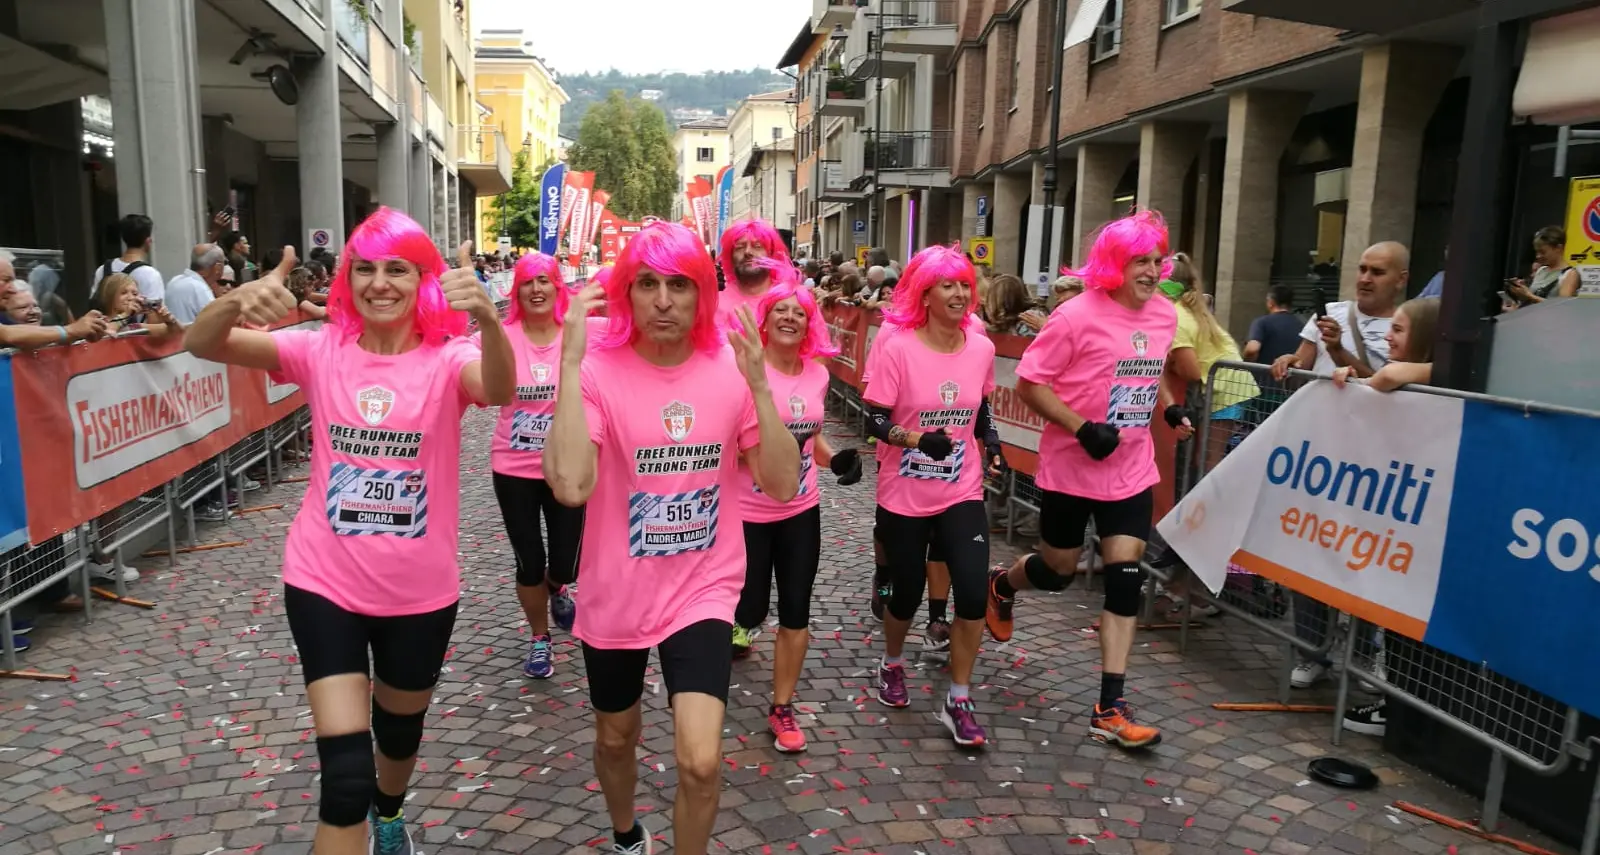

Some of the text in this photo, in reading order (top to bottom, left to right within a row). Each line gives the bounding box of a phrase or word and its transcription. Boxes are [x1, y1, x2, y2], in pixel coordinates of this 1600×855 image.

[1131, 393, 1147, 405] 203
[75, 372, 224, 463] FISHERMAN'S FRIEND
[531, 420, 548, 432] 247
[330, 424, 422, 444] FREE RUNNERS
[332, 439, 419, 458] STRONG TEAM
[636, 443, 722, 460] FREE RUNNERS
[638, 458, 720, 474] STRONG TEAM
[363, 480, 395, 501] 250
[1266, 440, 1435, 526] olomiti
[341, 499, 413, 513] FISHERMAN'S FRIEND
[667, 503, 692, 522] 515
[357, 512, 395, 525] CHIARA
[646, 527, 708, 545] ANDREA MARIA
[1279, 506, 1415, 575] energia
